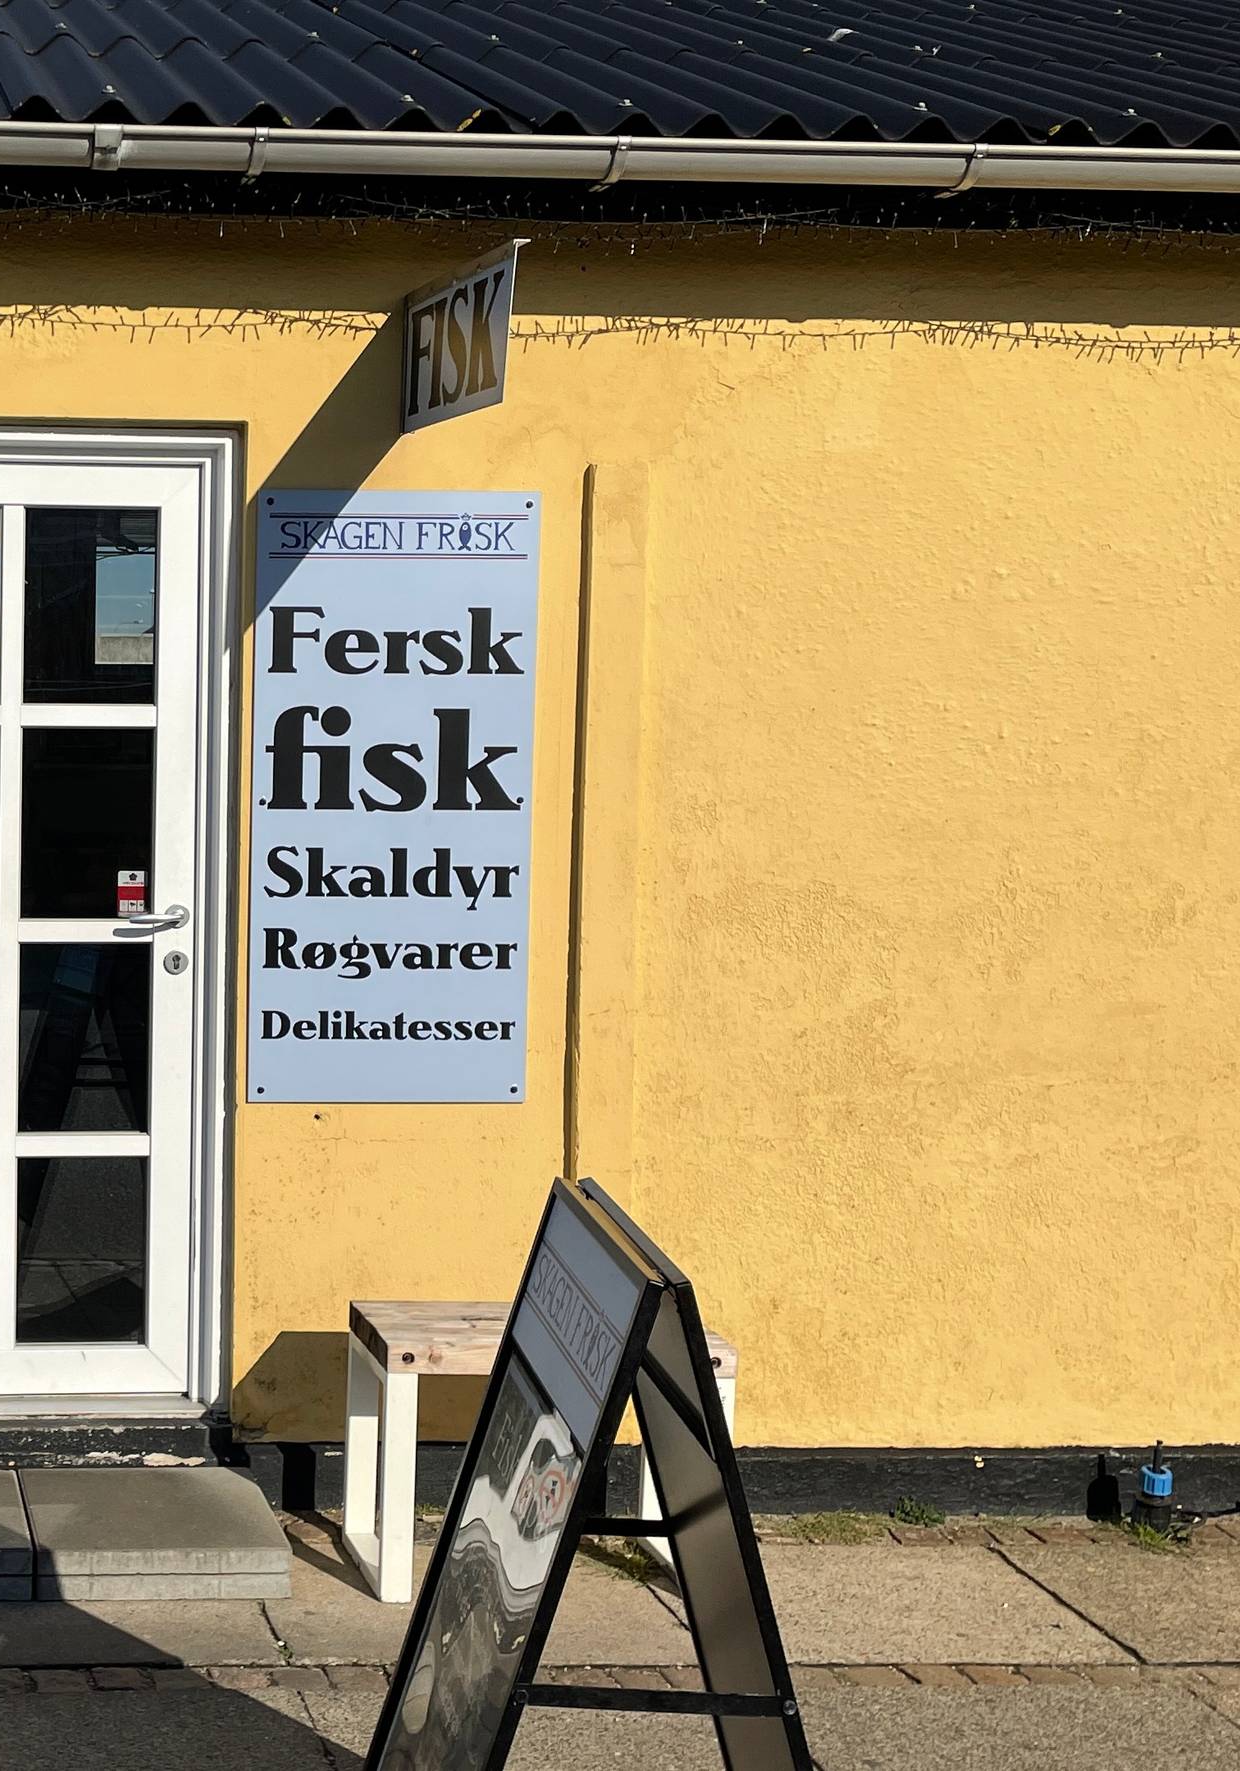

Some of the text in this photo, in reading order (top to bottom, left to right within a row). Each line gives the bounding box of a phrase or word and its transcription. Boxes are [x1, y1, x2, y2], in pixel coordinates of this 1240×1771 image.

[408, 269, 505, 417] FISK
[280, 520, 405, 550] SKAGEN
[267, 605, 525, 675] Fersk
[265, 705, 521, 811] fisk
[263, 845, 520, 911] Skaldyr
[262, 927, 518, 980] Røgvarer
[261, 1010, 516, 1041] Delikatesser
[533, 1254, 579, 1338] SKAGEN
